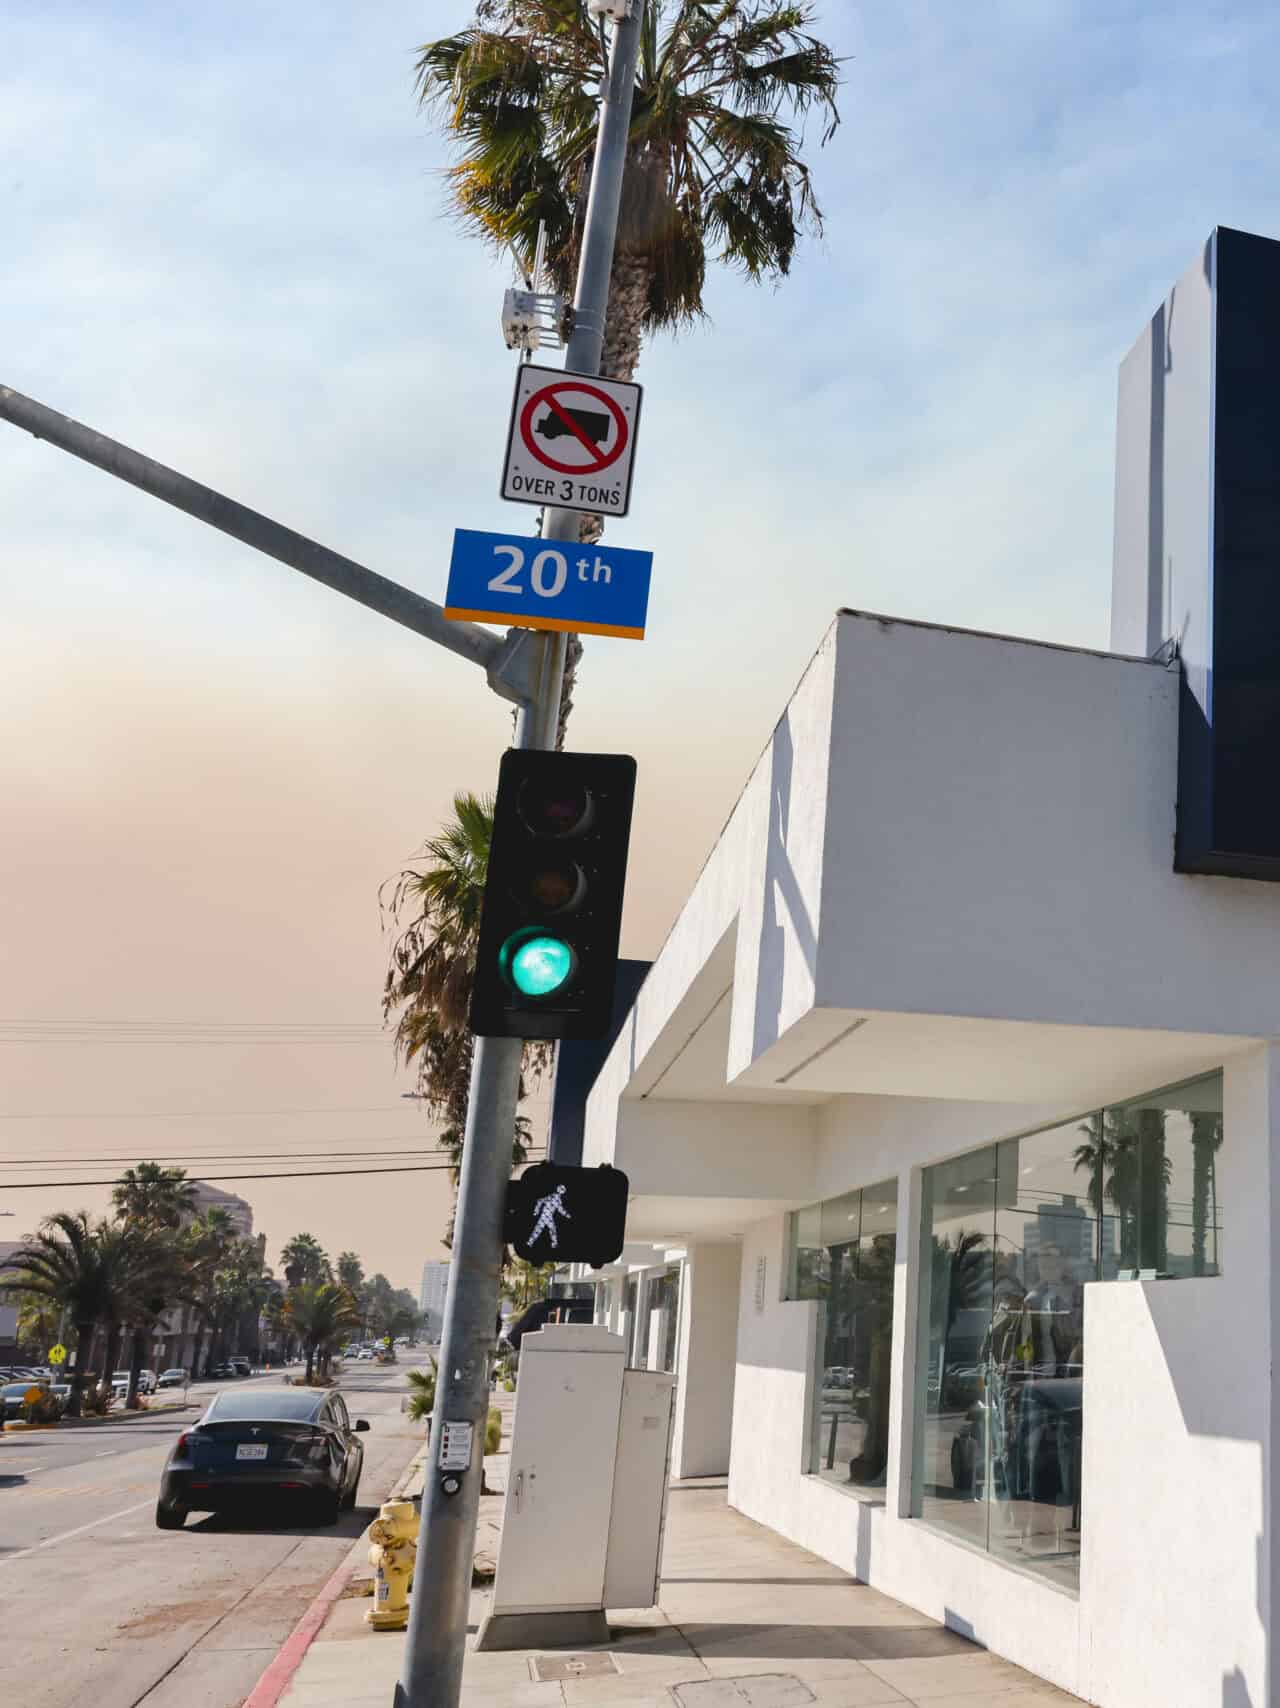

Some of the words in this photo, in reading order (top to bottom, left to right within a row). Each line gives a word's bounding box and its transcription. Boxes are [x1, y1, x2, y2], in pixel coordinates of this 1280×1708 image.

[512, 475, 556, 497] OVER
[559, 480, 573, 501] 3
[579, 486, 621, 506] TONS
[487, 545, 613, 599] 20th
